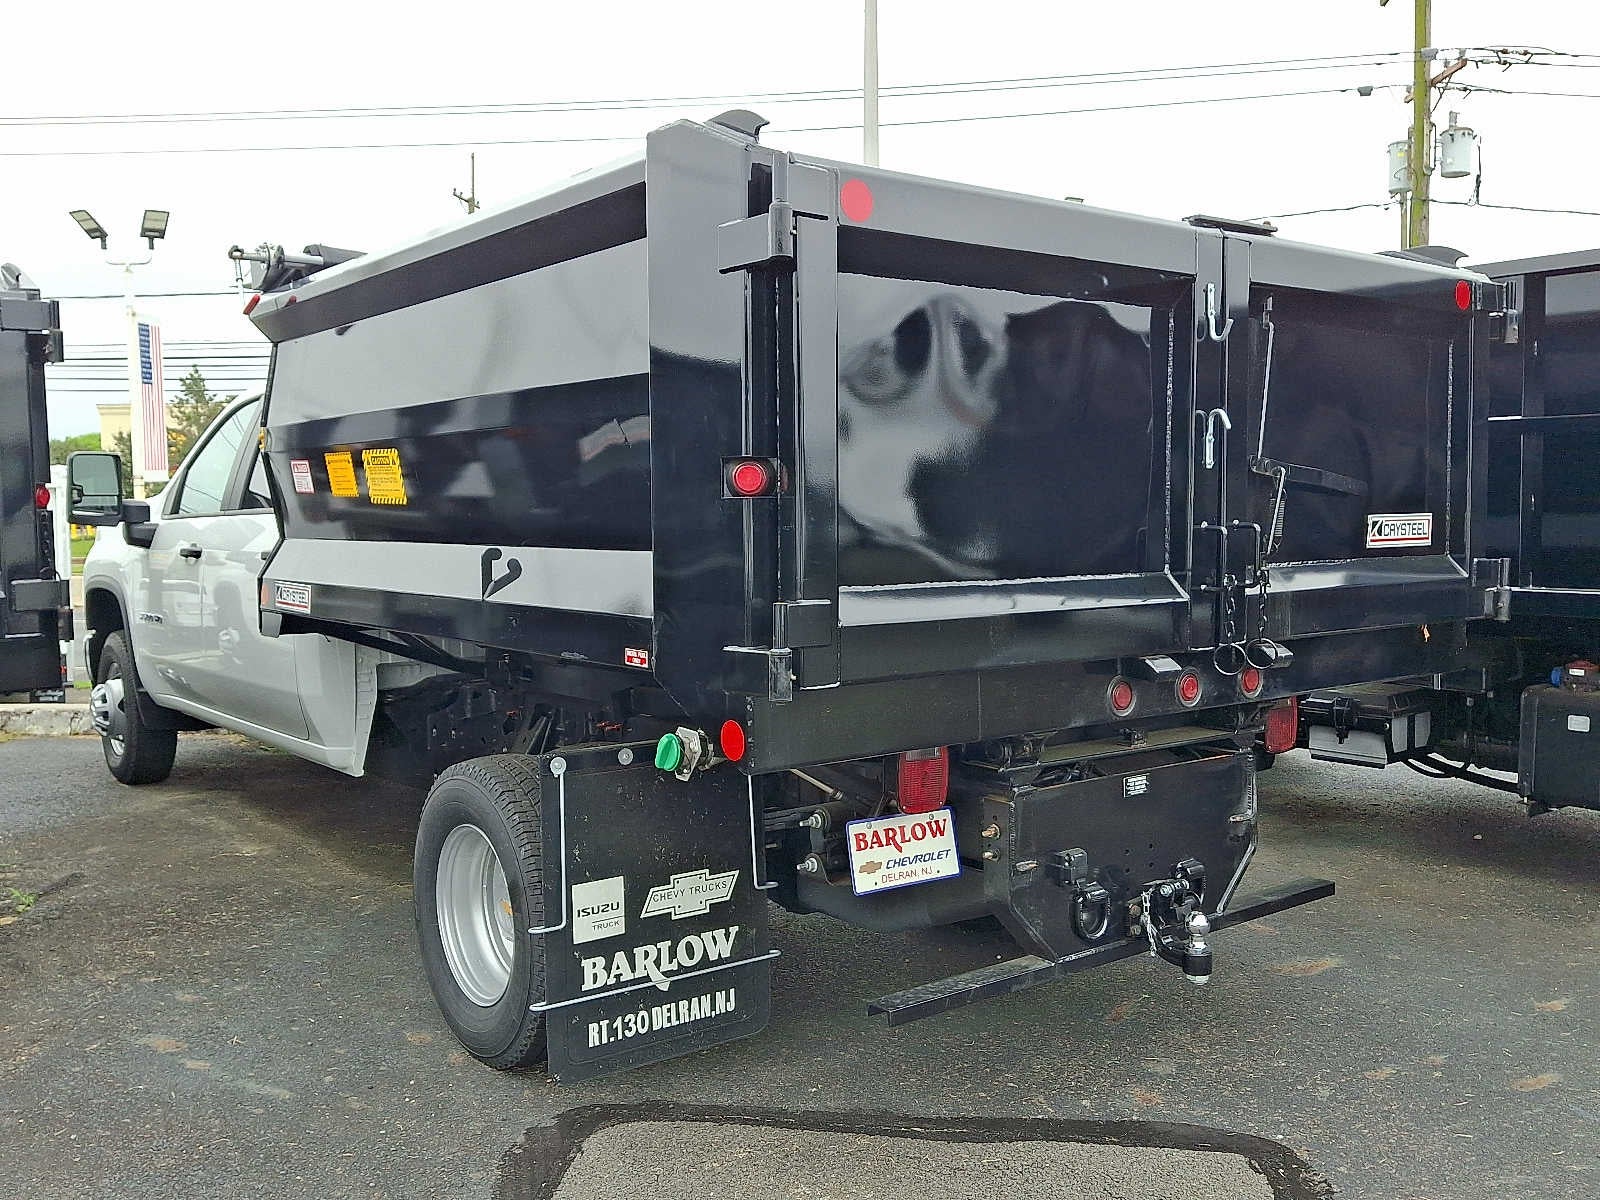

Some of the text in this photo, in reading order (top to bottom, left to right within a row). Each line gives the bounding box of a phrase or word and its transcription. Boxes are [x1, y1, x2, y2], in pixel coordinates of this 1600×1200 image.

[854, 819, 947, 853] BARLOW
[886, 849, 951, 870] CHEVROLET
[881, 866, 933, 884] DELRAN, NJ
[653, 880, 728, 903] CHEVY TRUCKS
[577, 901, 620, 919] ISUZU
[592, 919, 621, 931] TRUCK
[581, 925, 739, 992] BARLOW
[588, 1010, 650, 1048] RT.130
